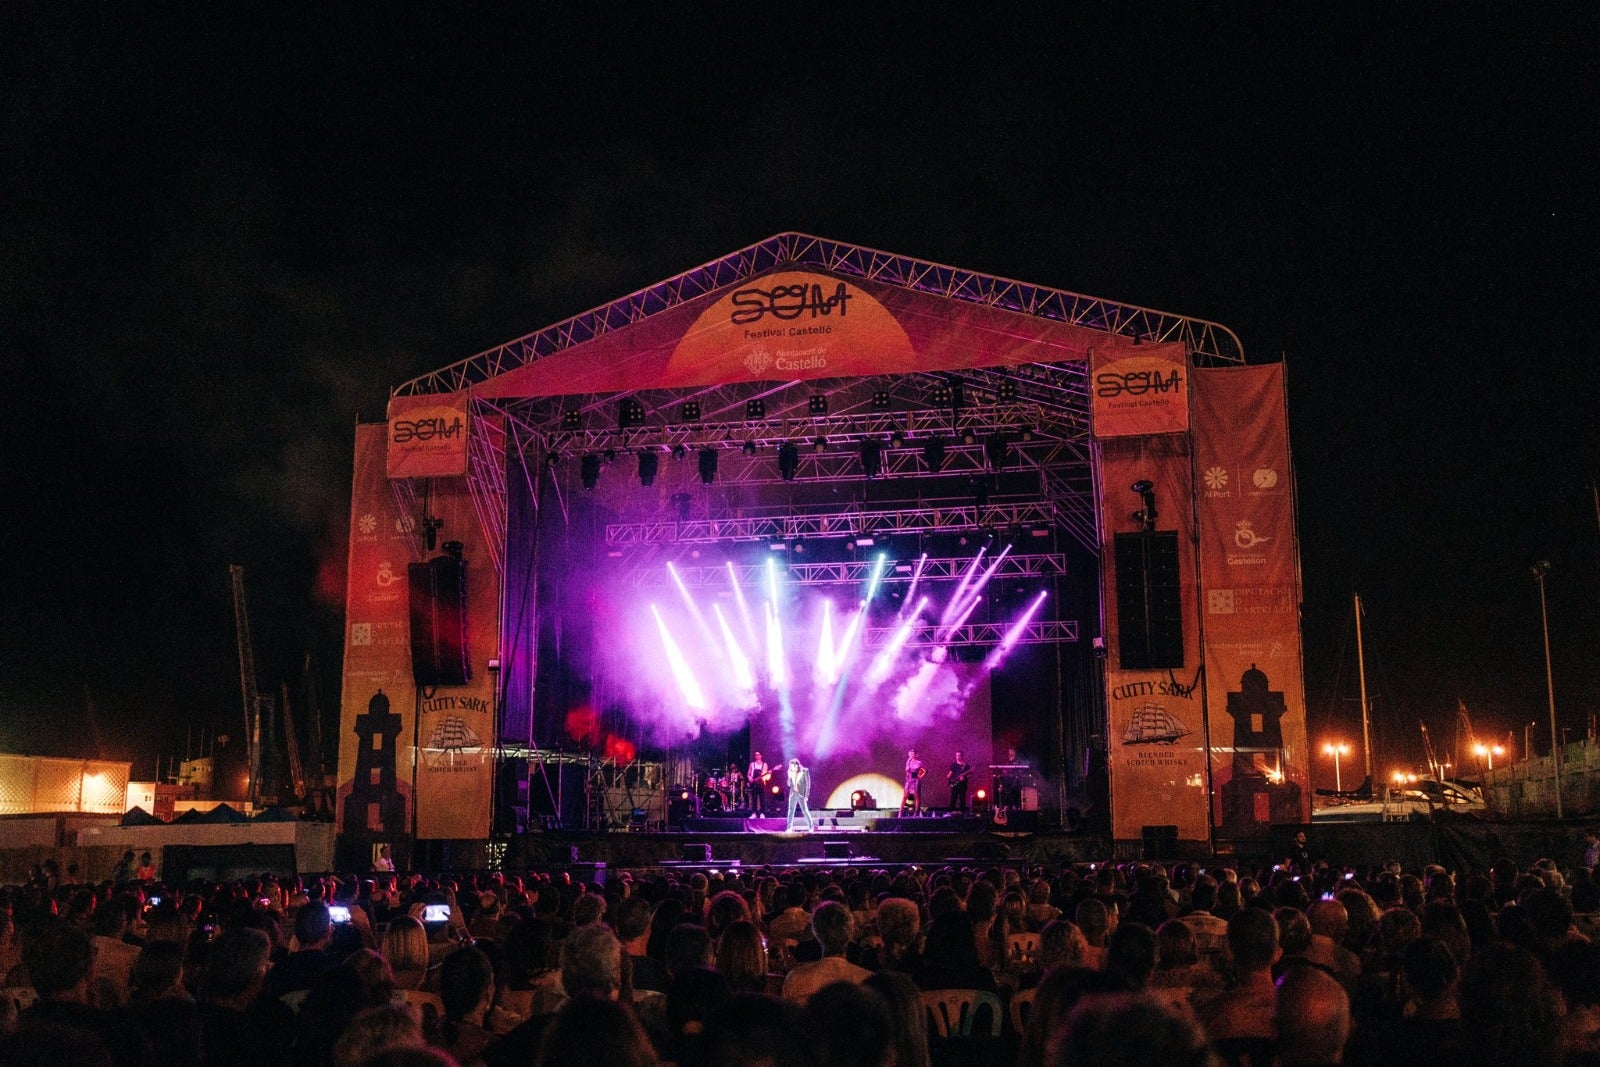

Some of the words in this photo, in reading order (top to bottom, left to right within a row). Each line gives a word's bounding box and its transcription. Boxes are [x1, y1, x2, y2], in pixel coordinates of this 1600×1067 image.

[744, 328, 785, 339] Festival
[789, 325, 832, 336] Castelló
[775, 354, 827, 370] Castelló
[1112, 681, 1156, 701] CUTTY
[422, 697, 457, 714] CUTTY
[459, 696, 490, 713] SARK
